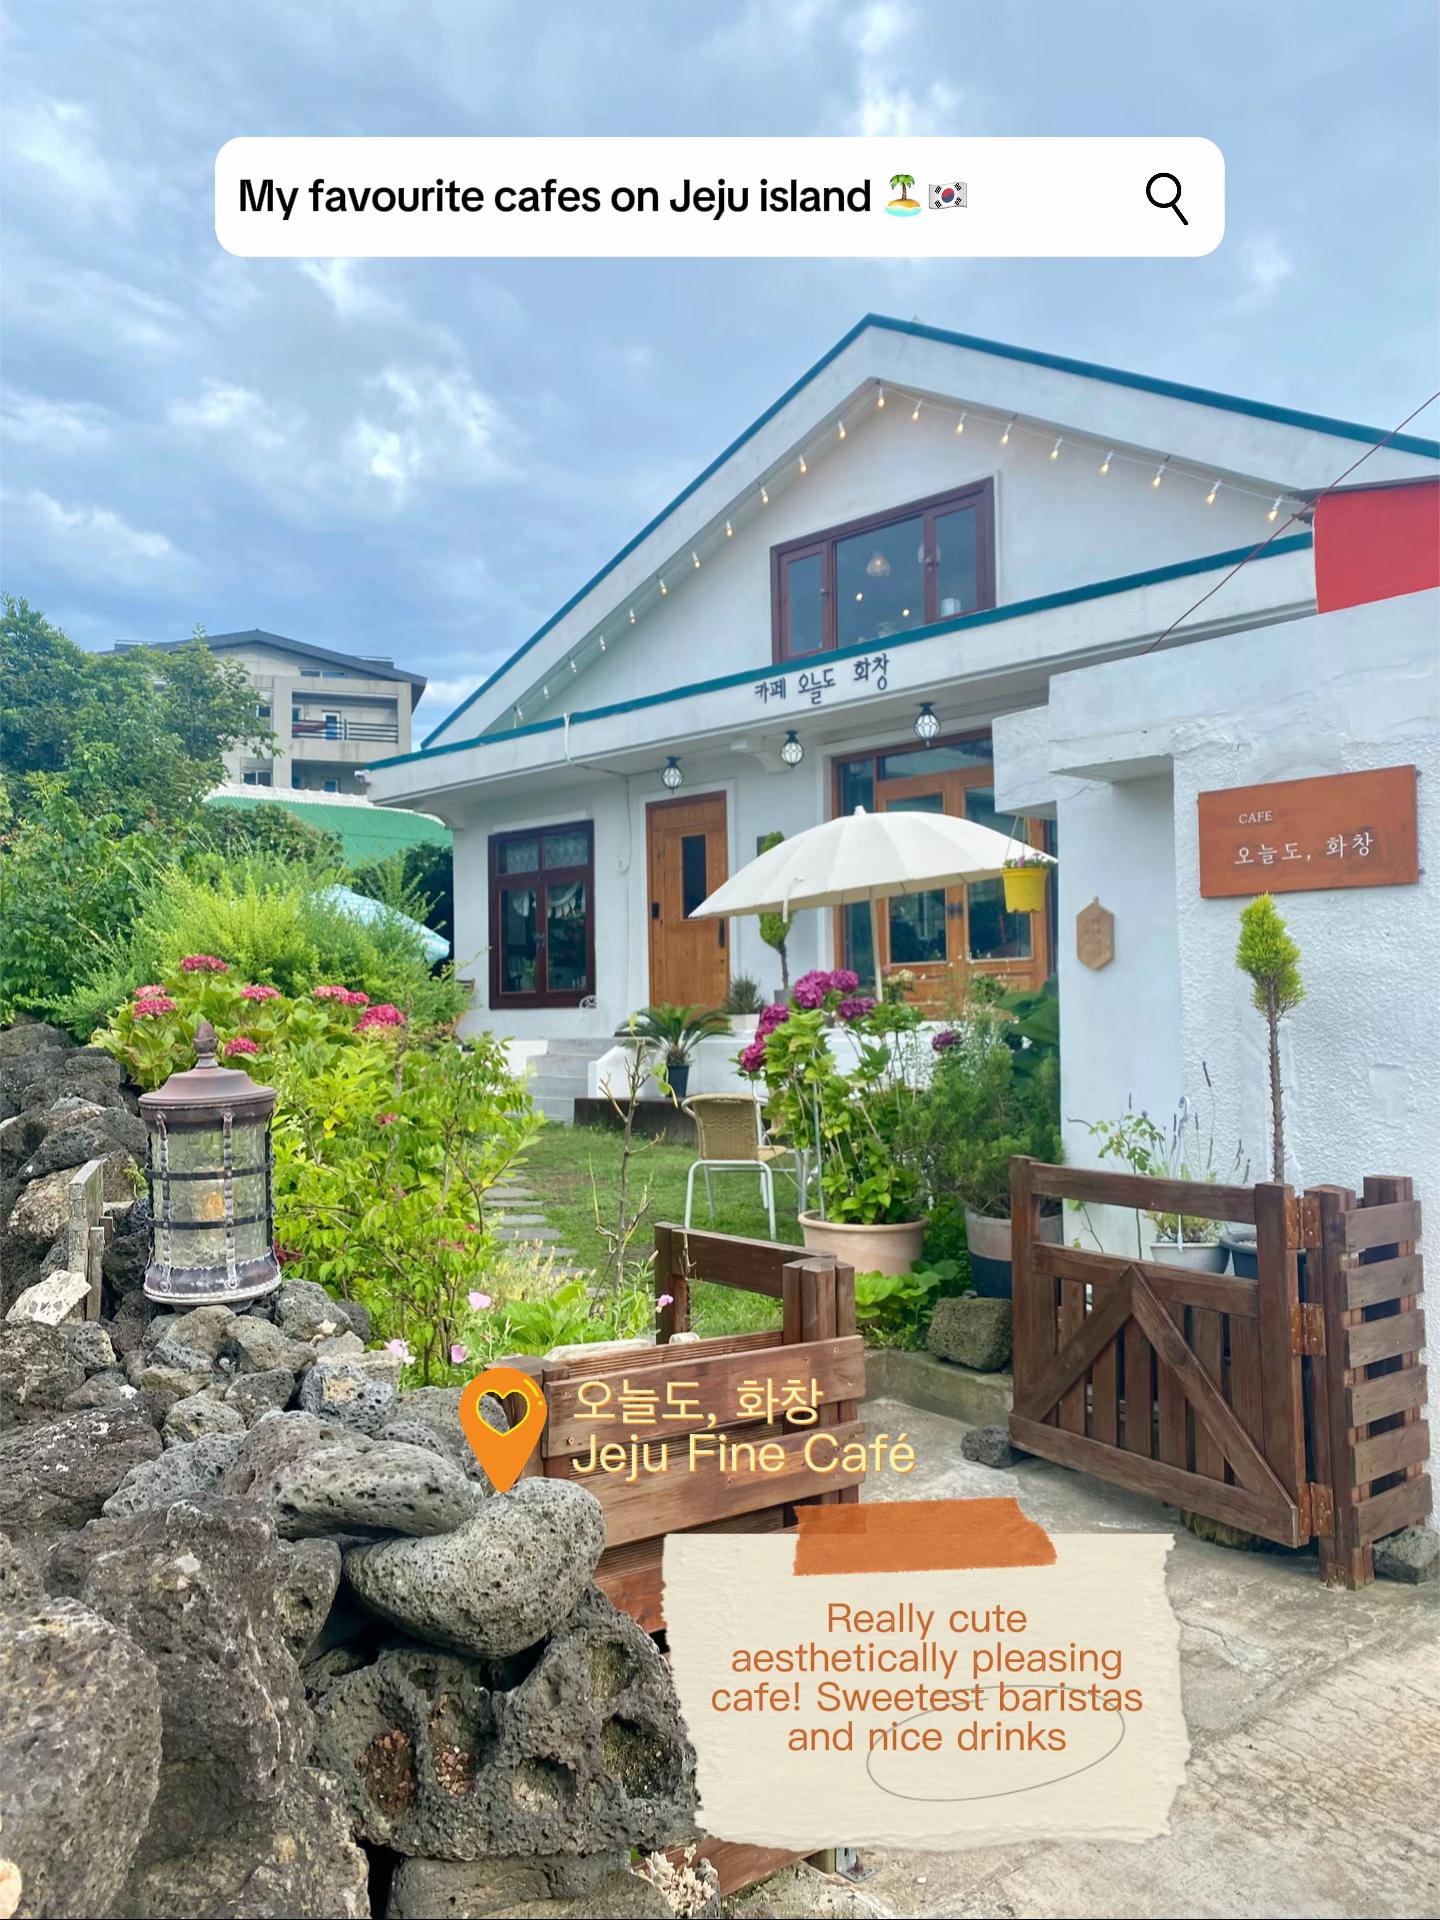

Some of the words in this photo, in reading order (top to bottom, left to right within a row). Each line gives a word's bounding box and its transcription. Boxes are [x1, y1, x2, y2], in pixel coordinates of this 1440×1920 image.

[754, 676, 787, 704] 카페
[798, 668, 836, 705] 오늘도
[853, 653, 890, 691] 화창
[1238, 810, 1273, 825] CAFE
[1235, 841, 1312, 865] 오늘도,
[1326, 831, 1374, 859] 화창
